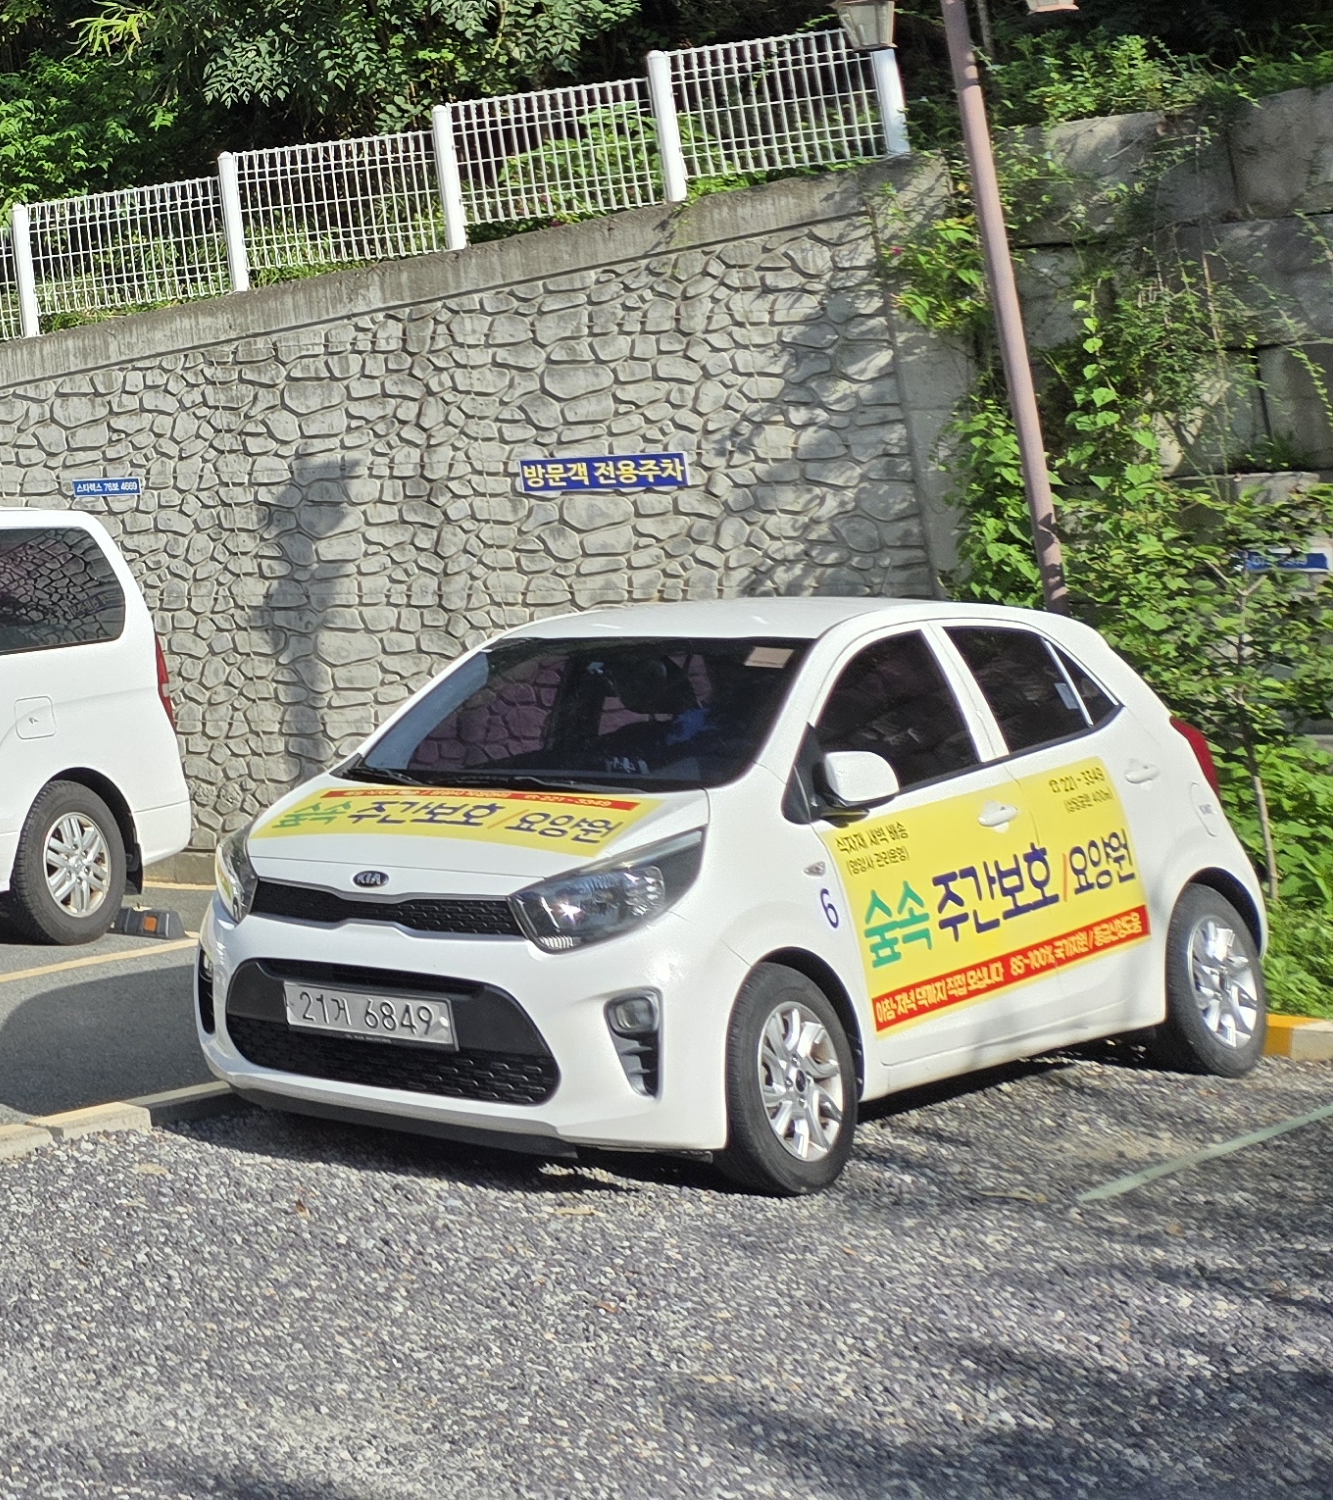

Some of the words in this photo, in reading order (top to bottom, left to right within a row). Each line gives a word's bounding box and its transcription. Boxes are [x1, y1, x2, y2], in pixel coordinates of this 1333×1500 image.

[76, 482, 103, 493] 스타렉스
[121, 480, 138, 491] 4669
[523, 462, 590, 488] 방문객
[594, 457, 685, 485] 전용주차
[1060, 775, 1078, 792] 221
[272, 801, 352, 829] 숲속
[348, 801, 507, 827] 주간보호
[505, 812, 623, 844] 요양원
[835, 831, 869, 855] 식자재
[867, 826, 890, 846] 새벽
[886, 821, 909, 841] 배송
[845, 857, 876, 877] (영양사
[874, 845, 910, 869] 관리운영)
[356, 872, 382, 886] KIA
[819, 887, 840, 929] 6
[864, 880, 933, 969] 숲속
[932, 841, 1060, 943] 주간보호
[1068, 828, 1137, 895] 요양원
[946, 973, 968, 997] 직접
[966, 960, 1004, 991] 모십니다
[299, 991, 352, 1026] 21거
[364, 997, 435, 1036] 6849
